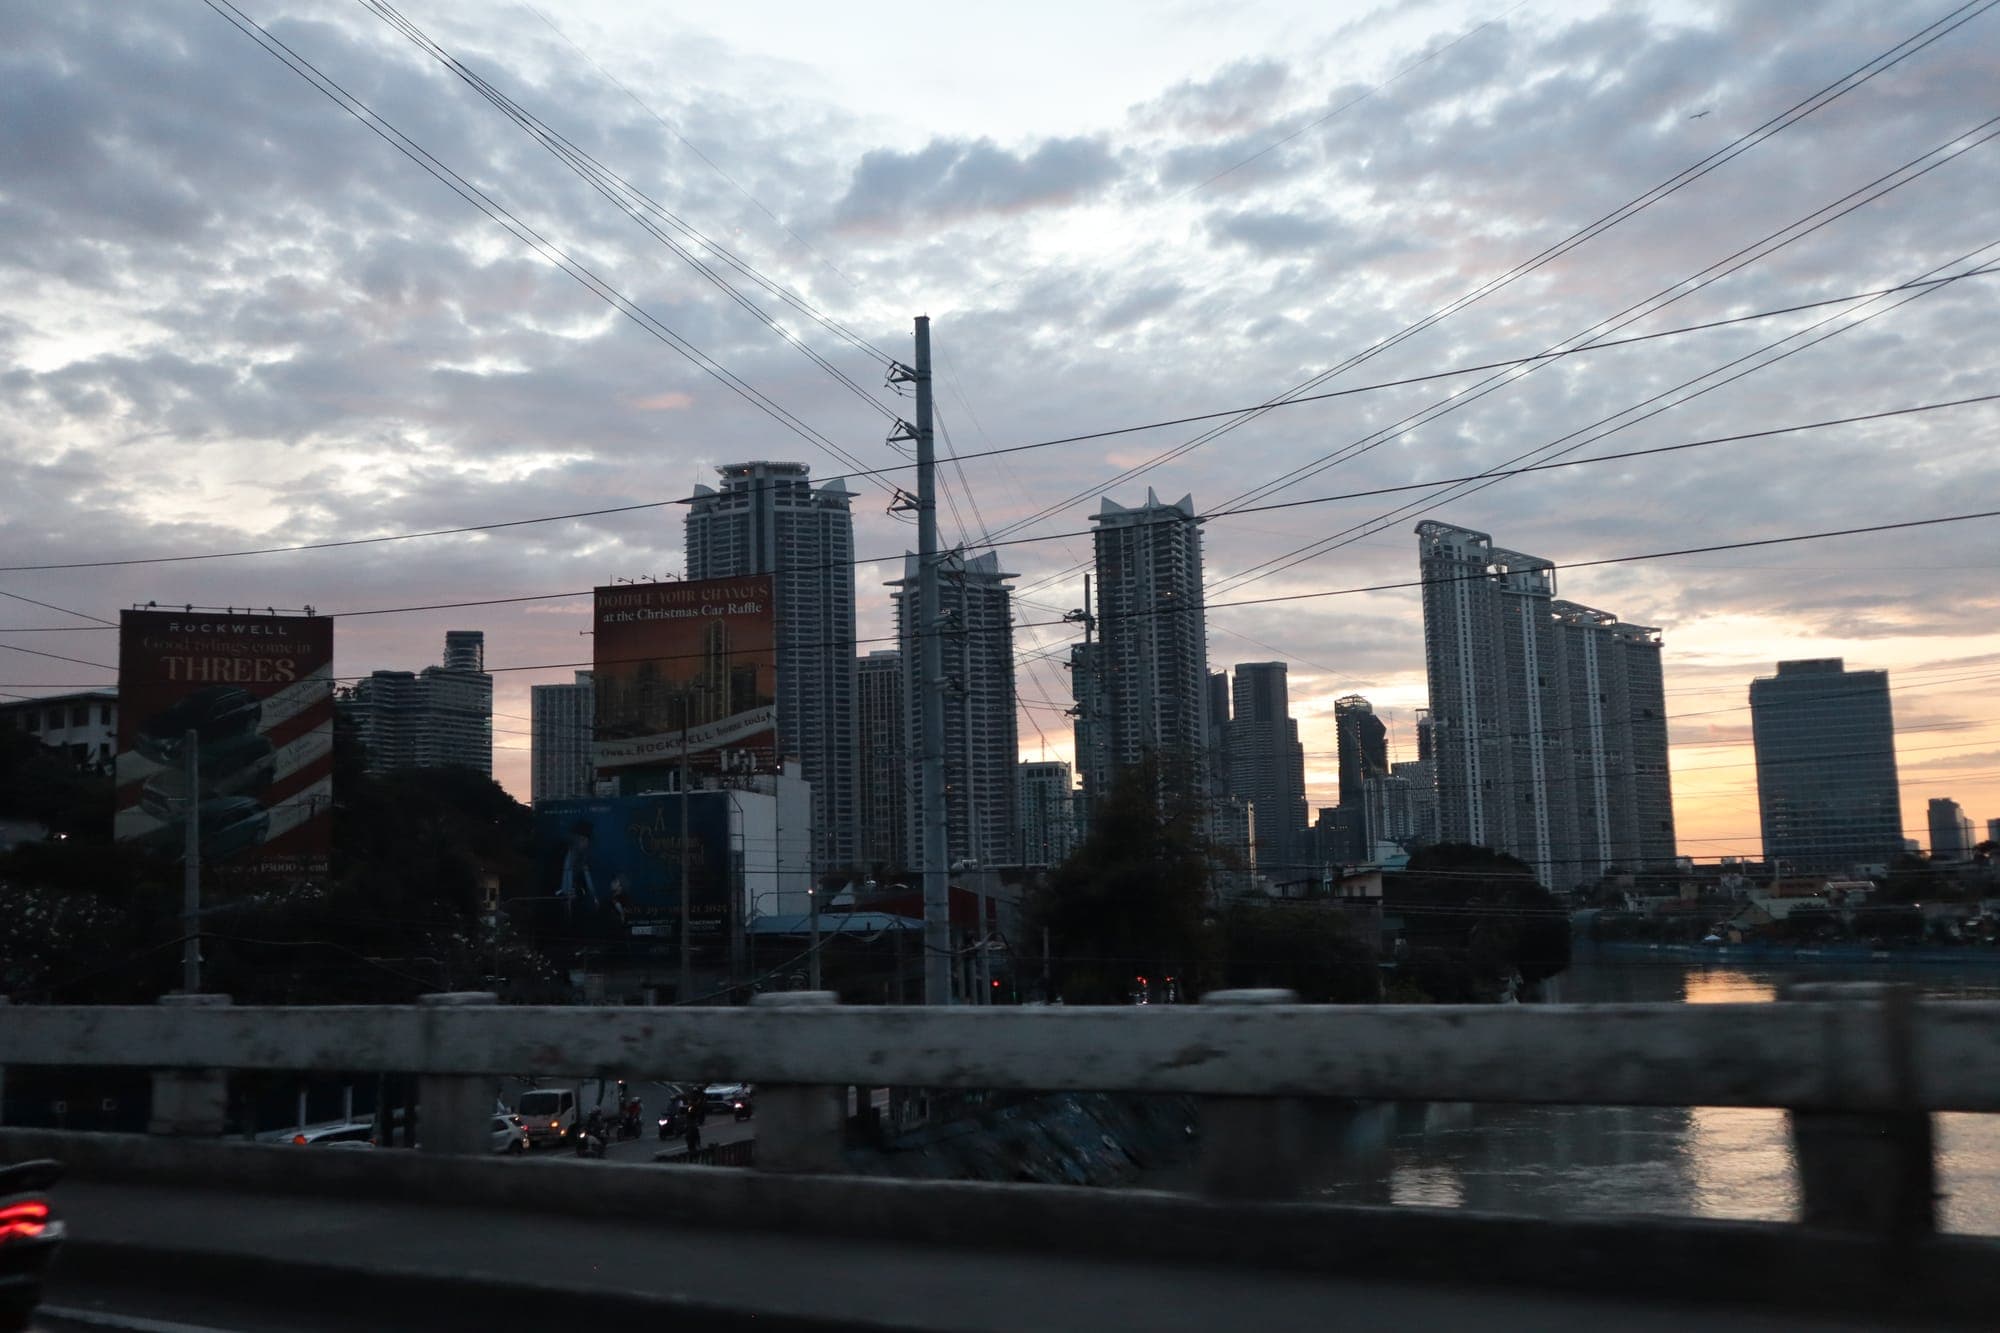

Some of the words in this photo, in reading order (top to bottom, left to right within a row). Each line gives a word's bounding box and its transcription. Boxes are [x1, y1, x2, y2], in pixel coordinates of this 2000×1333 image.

[598, 594, 655, 607] DOUBLE
[660, 590, 695, 603] YOUR
[701, 584, 769, 600] CHANCES
[603, 614, 615, 622] at
[616, 610, 634, 622] the
[636, 607, 698, 620] Christmas
[701, 604, 726, 616] Car
[728, 601, 763, 614] Raffle
[169, 623, 288, 635] ROCKWELL
[296, 638, 312, 654] in
[160, 655, 296, 683] THREES
